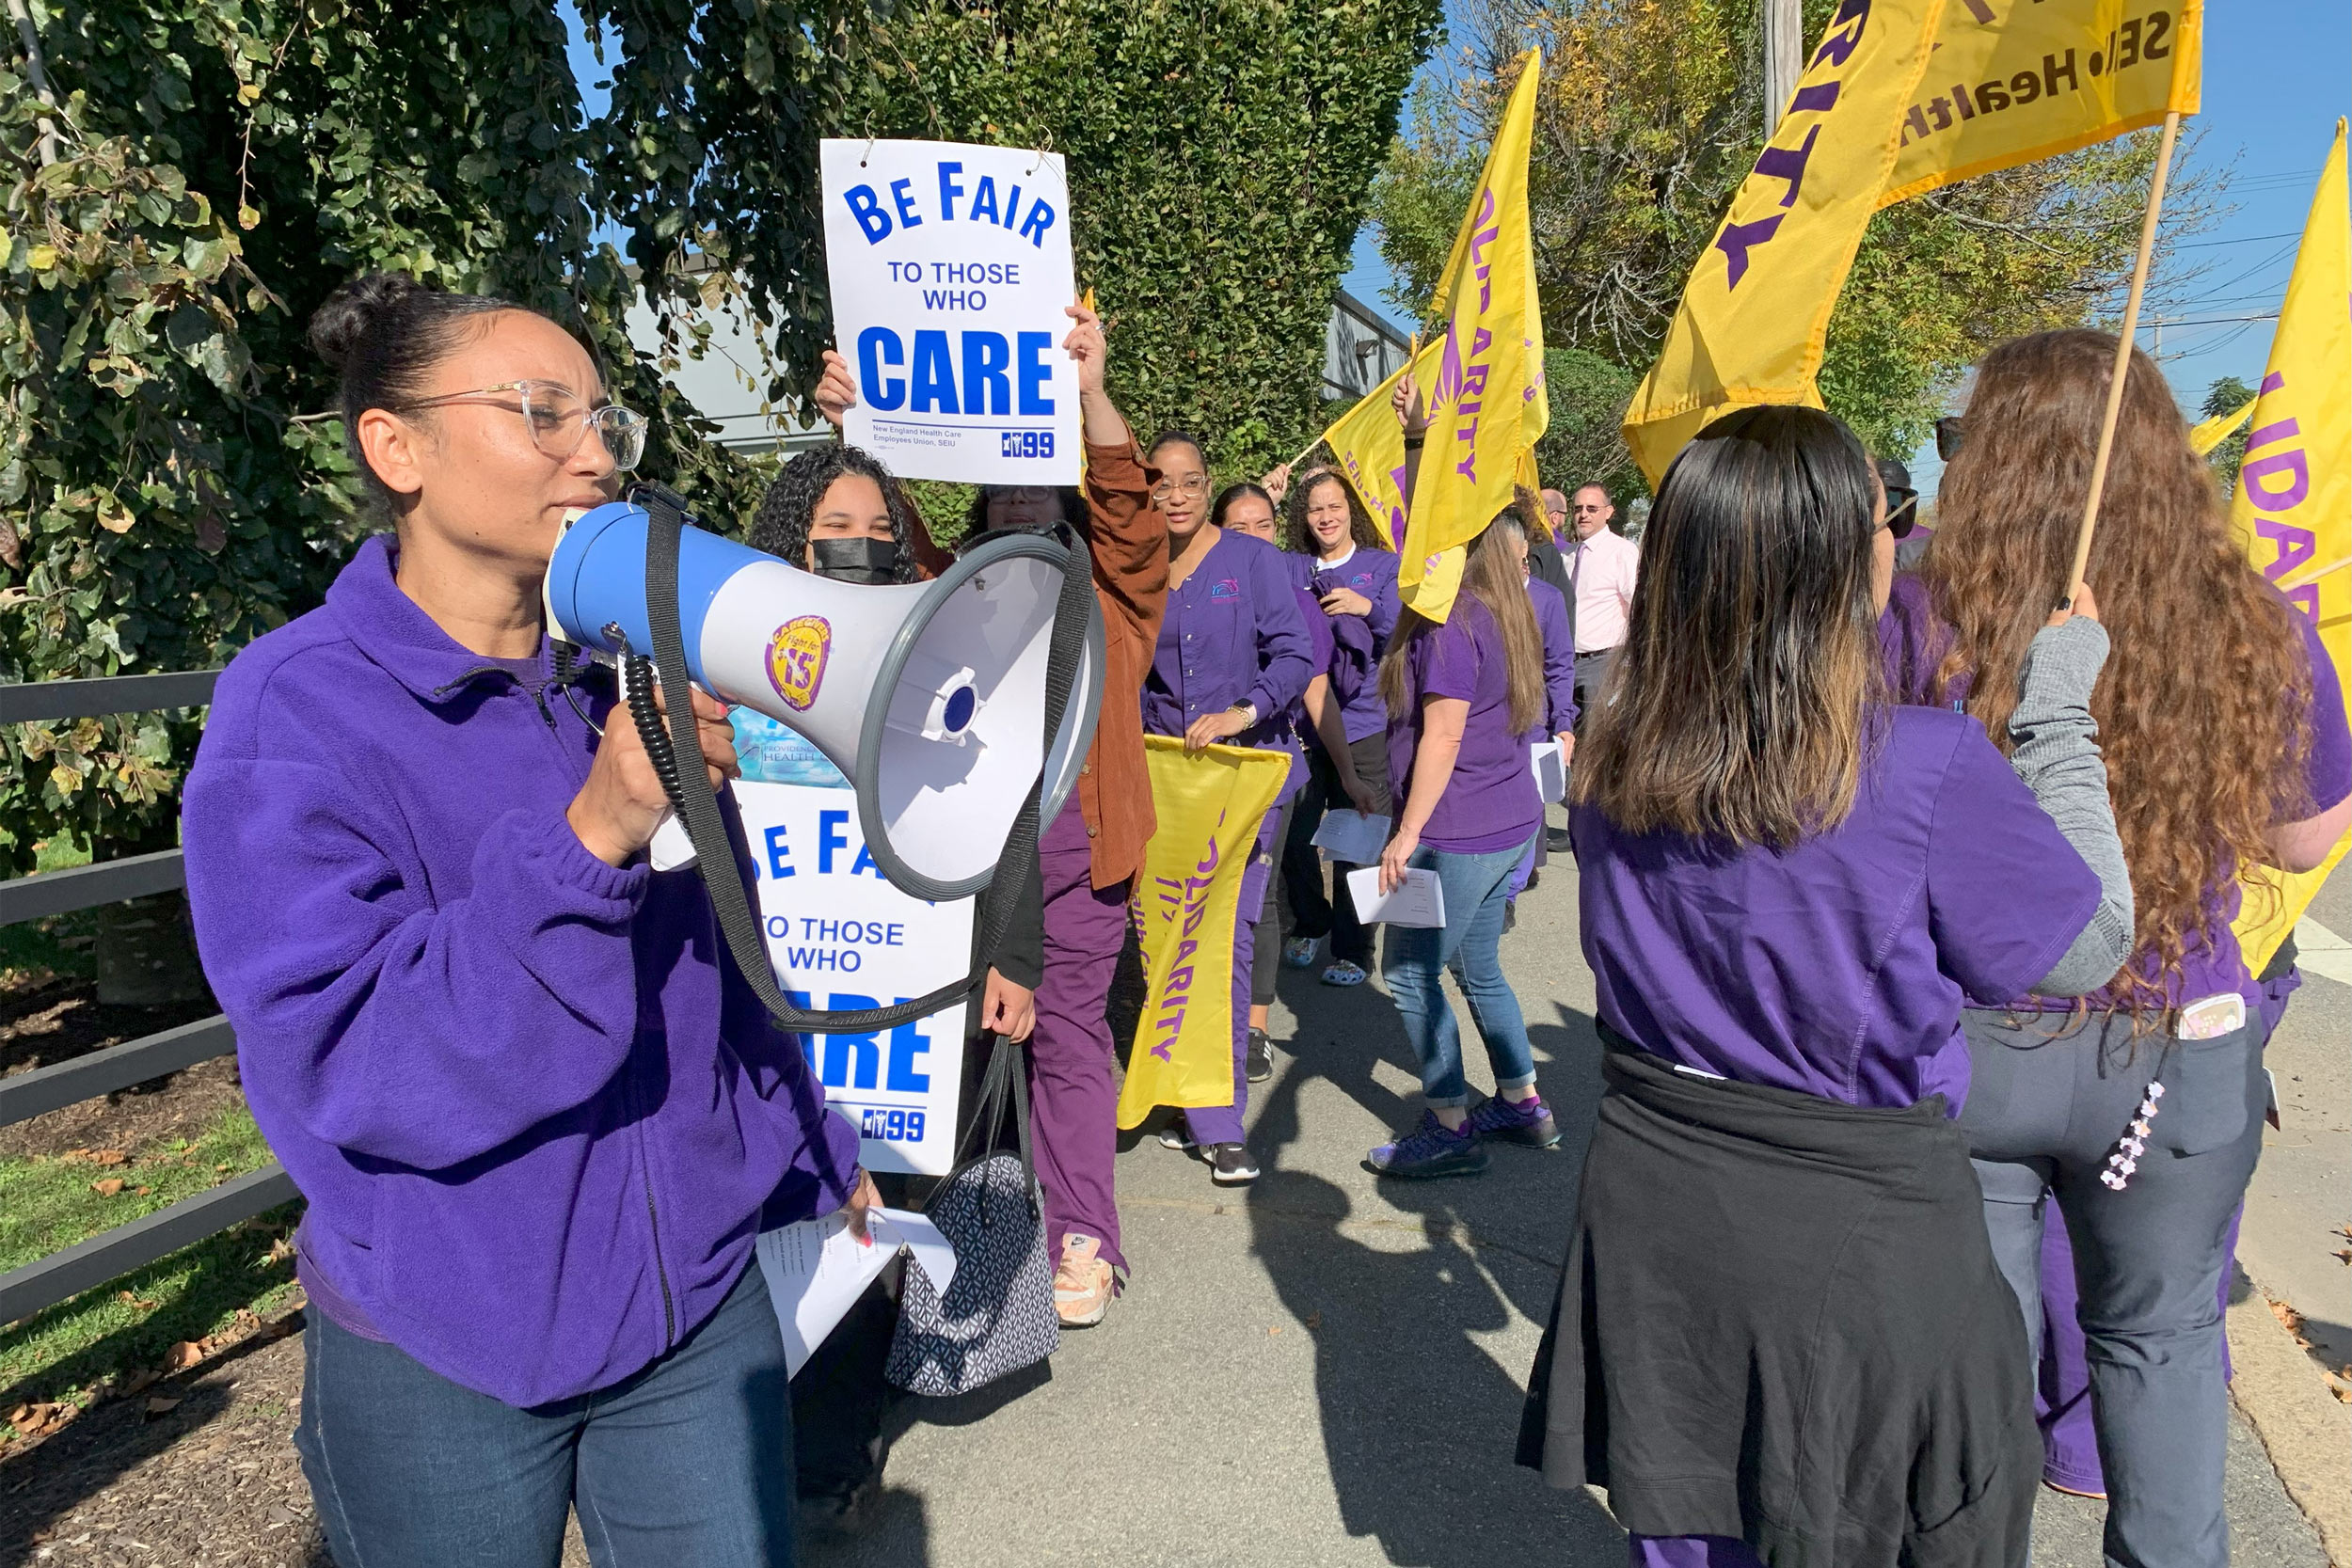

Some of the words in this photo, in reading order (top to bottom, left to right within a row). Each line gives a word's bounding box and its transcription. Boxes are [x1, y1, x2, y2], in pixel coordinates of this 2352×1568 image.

[843, 177, 923, 245] BE
[937, 162, 1055, 249] FAIR
[888, 261, 922, 283] TO
[930, 262, 1020, 284] THOSE
[923, 290, 987, 311] WHO
[857, 326, 1055, 416] CARE
[873, 424, 888, 433] New
[889, 426, 918, 436] England
[920, 428, 943, 437] Health
[944, 430, 961, 438] Care
[873, 434, 912, 444] Employees
[938, 438, 956, 448] SEIU
[787, 634, 807, 647] Fight
[808, 641, 819, 650] for
[764, 752, 815, 762] HEALTH
[752, 824, 797, 882] E
[818, 810, 887, 880] FA
[800, 918, 904, 946] THOSE
[787, 946, 862, 973] WHO
[782, 990, 934, 1093] RE
